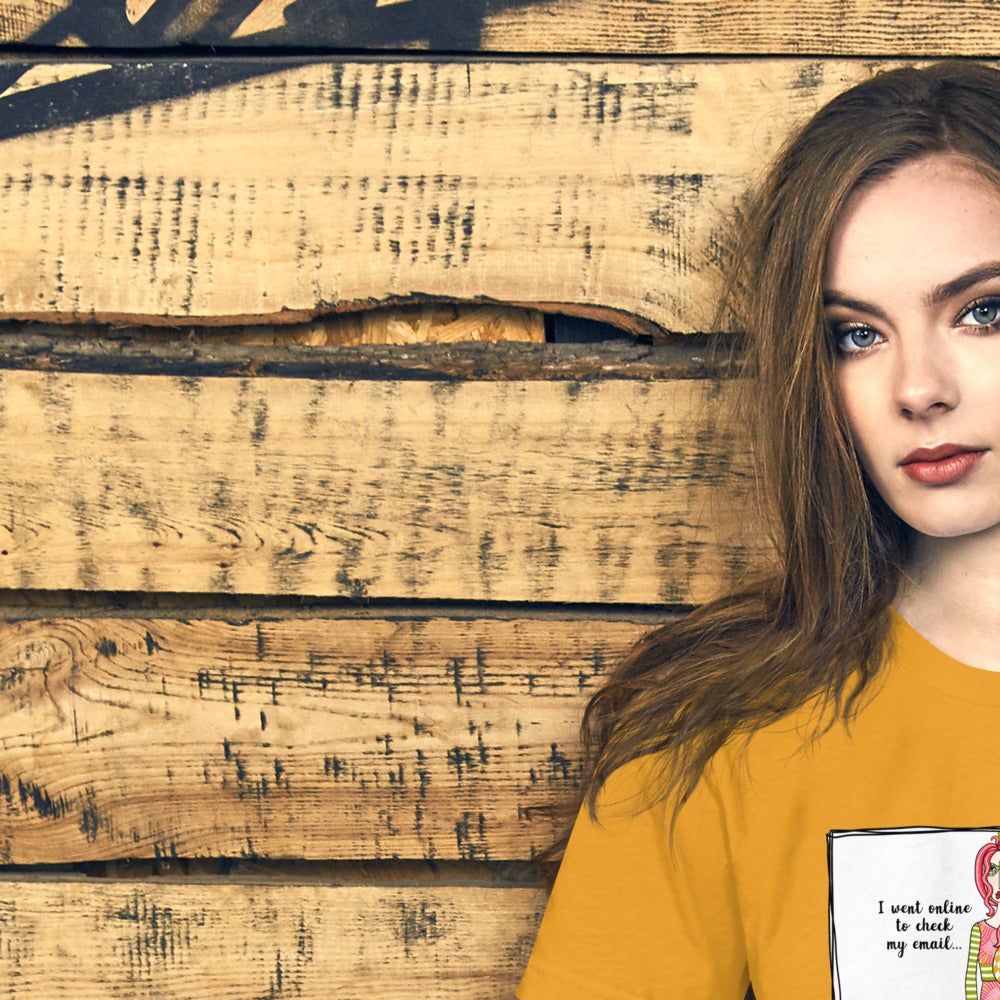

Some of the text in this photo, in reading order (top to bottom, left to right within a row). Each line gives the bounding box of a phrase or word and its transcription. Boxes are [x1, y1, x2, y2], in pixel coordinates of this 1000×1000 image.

[878, 899, 972, 915] I went online
[896, 917, 954, 932] to check
[886, 935, 962, 958] my email...
